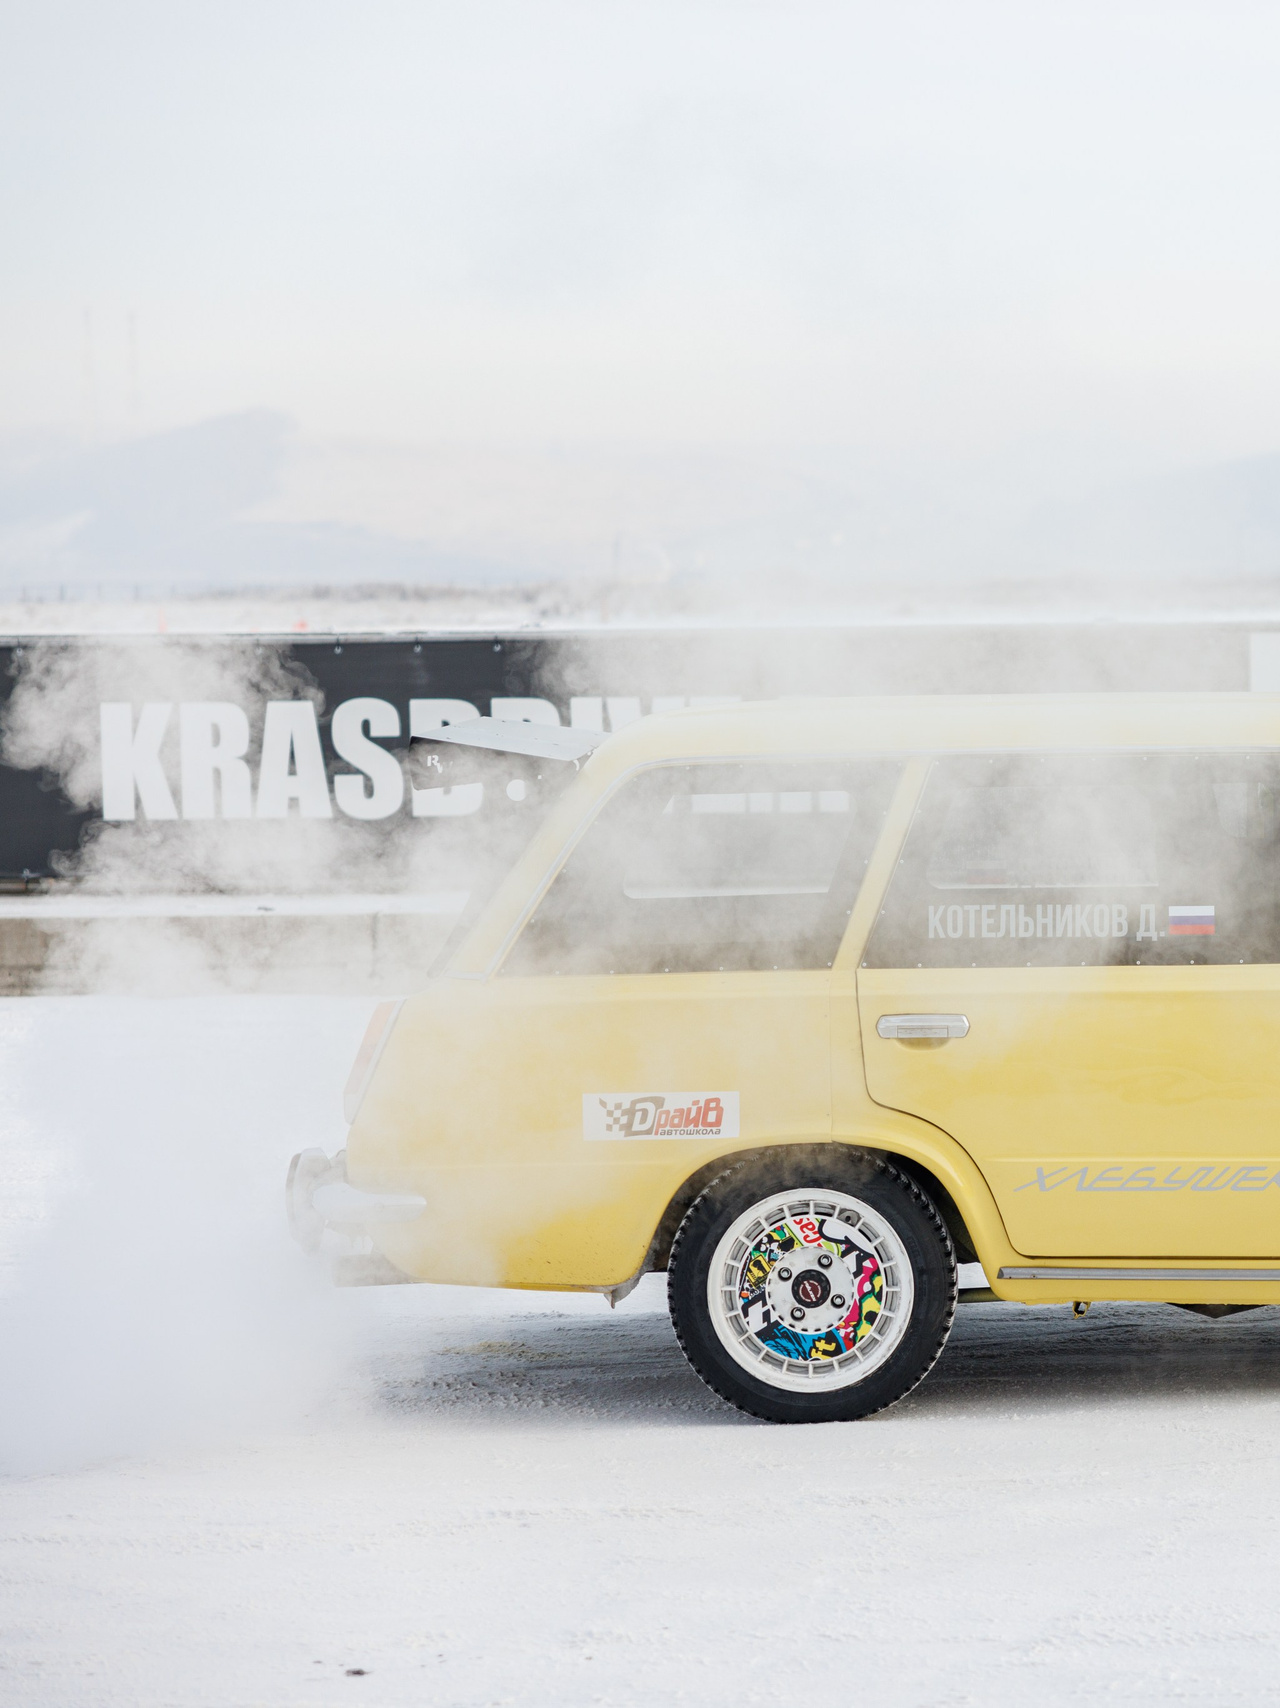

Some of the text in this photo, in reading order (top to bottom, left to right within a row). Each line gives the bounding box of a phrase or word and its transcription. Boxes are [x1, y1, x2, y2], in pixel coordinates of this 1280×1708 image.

[928, 903, 1166, 941] КОТЕЛЬНИКОВ Д.
[659, 1128, 722, 1136] автошкола
